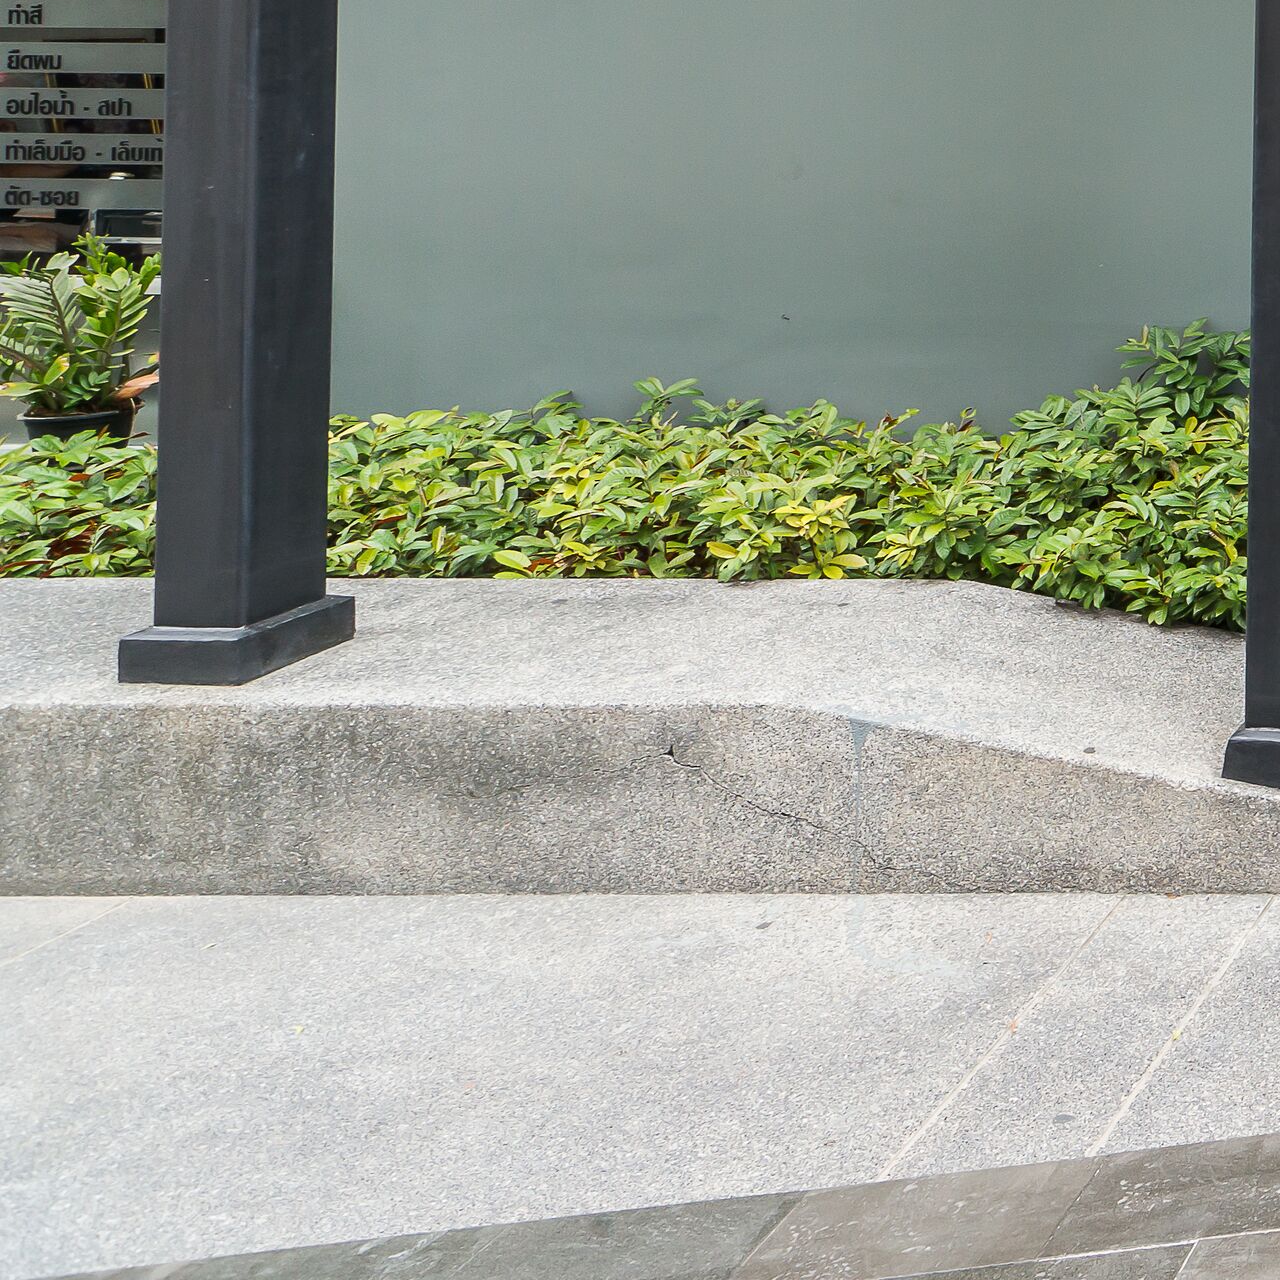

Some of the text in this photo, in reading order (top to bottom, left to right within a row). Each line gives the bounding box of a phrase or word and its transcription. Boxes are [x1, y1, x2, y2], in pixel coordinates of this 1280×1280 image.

[7, 3, 44, 25] ทำสี
[97, 97, 133, 117] สปา
[111, 137, 165, 162] เล็บเท้
